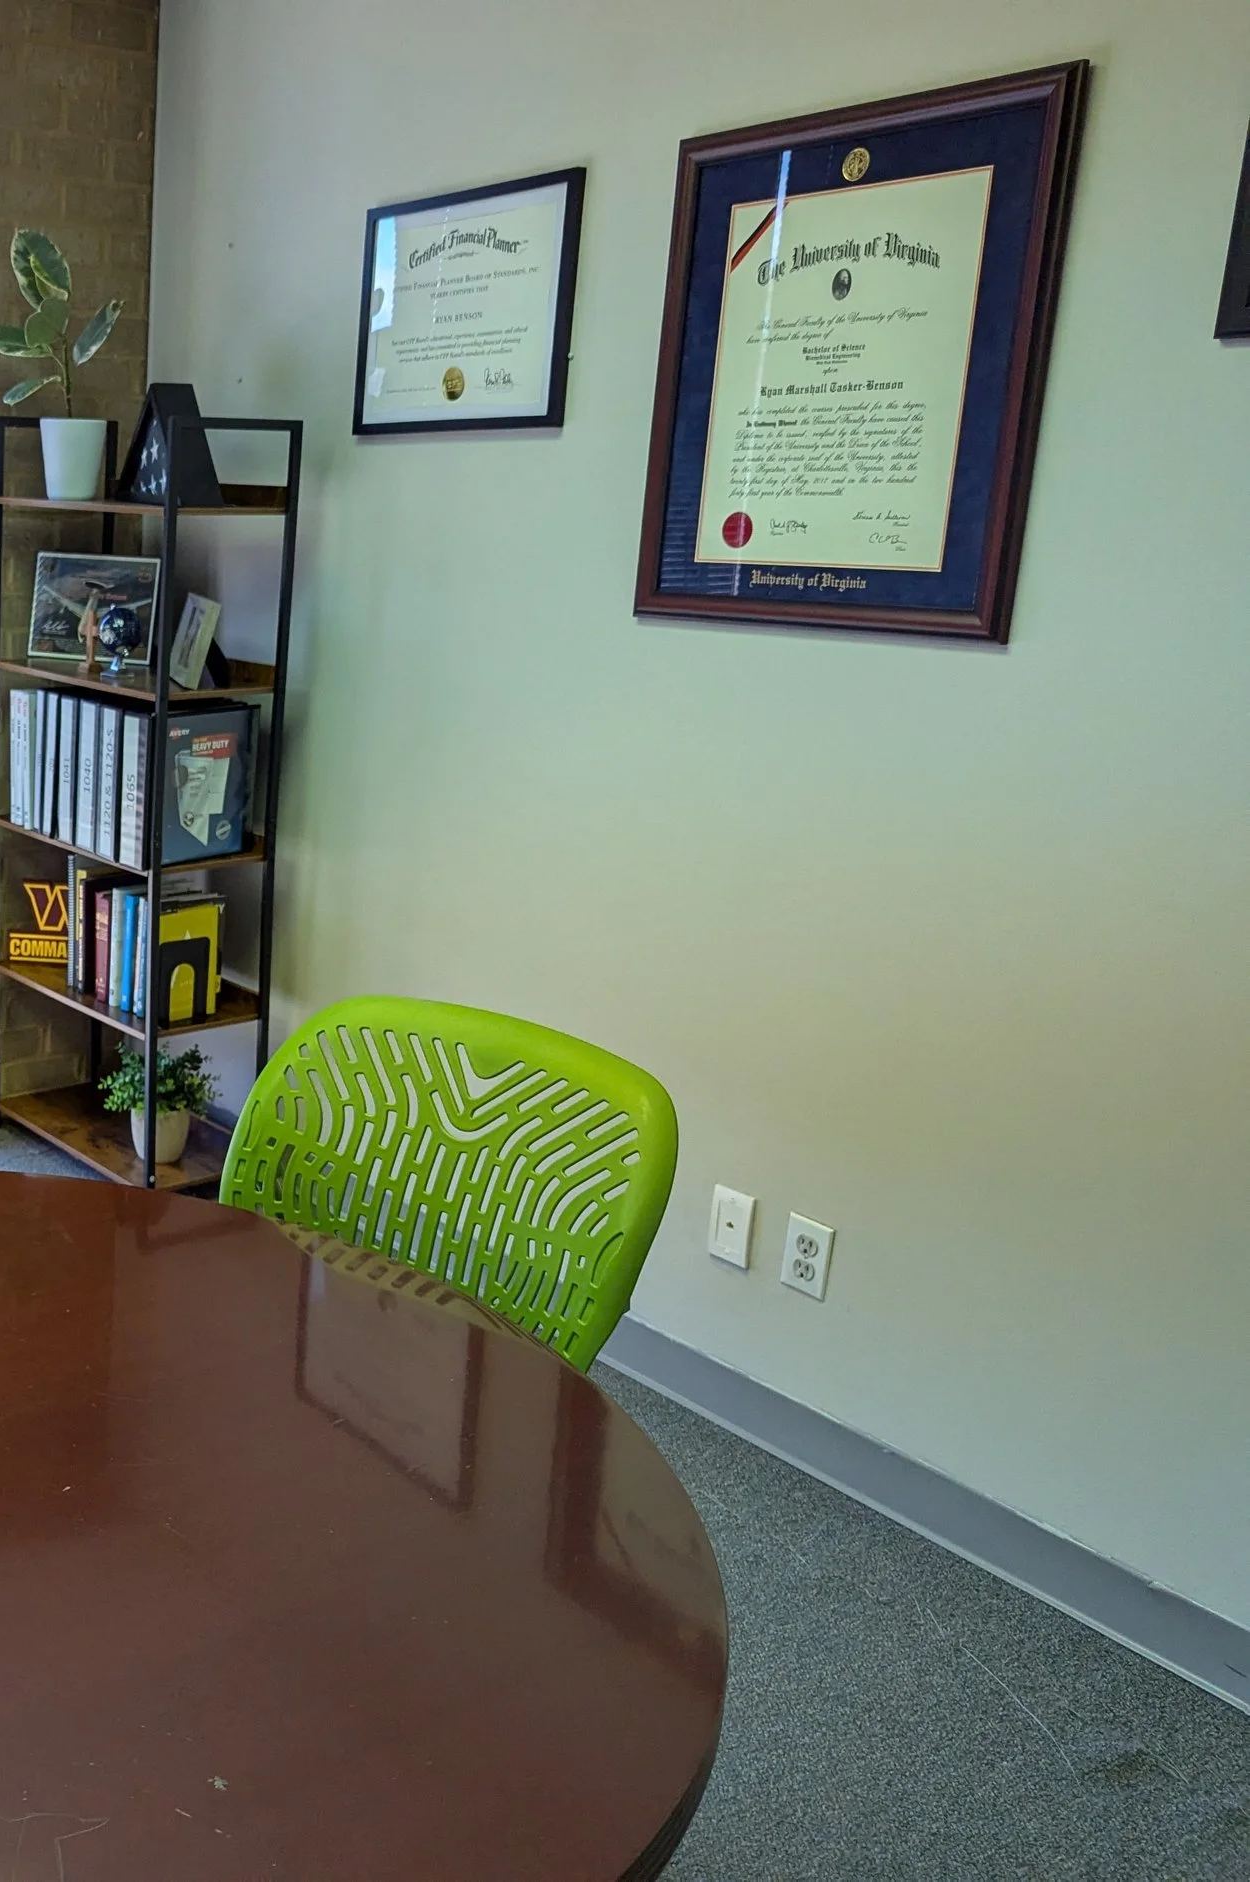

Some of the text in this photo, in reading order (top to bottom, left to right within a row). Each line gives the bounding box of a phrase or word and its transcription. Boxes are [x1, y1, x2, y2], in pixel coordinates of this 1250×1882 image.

[409, 226, 521, 269] Certified Financial Planner
[758, 232, 940, 286] The University of Virginia
[454, 311, 483, 322] BENSON
[841, 343, 866, 352] Science
[760, 380, 904, 398] Ryan Marshall Tasker-Benson
[750, 570, 868, 592] University of Virginia
[169, 728, 190, 738] AVERY
[192, 740, 212, 752] HEAVY
[212, 738, 230, 750] DUTY
[82, 757, 92, 794] 1040
[103, 727, 114, 838] 1120 & 1120-S
[125, 773, 136, 810] 1065
